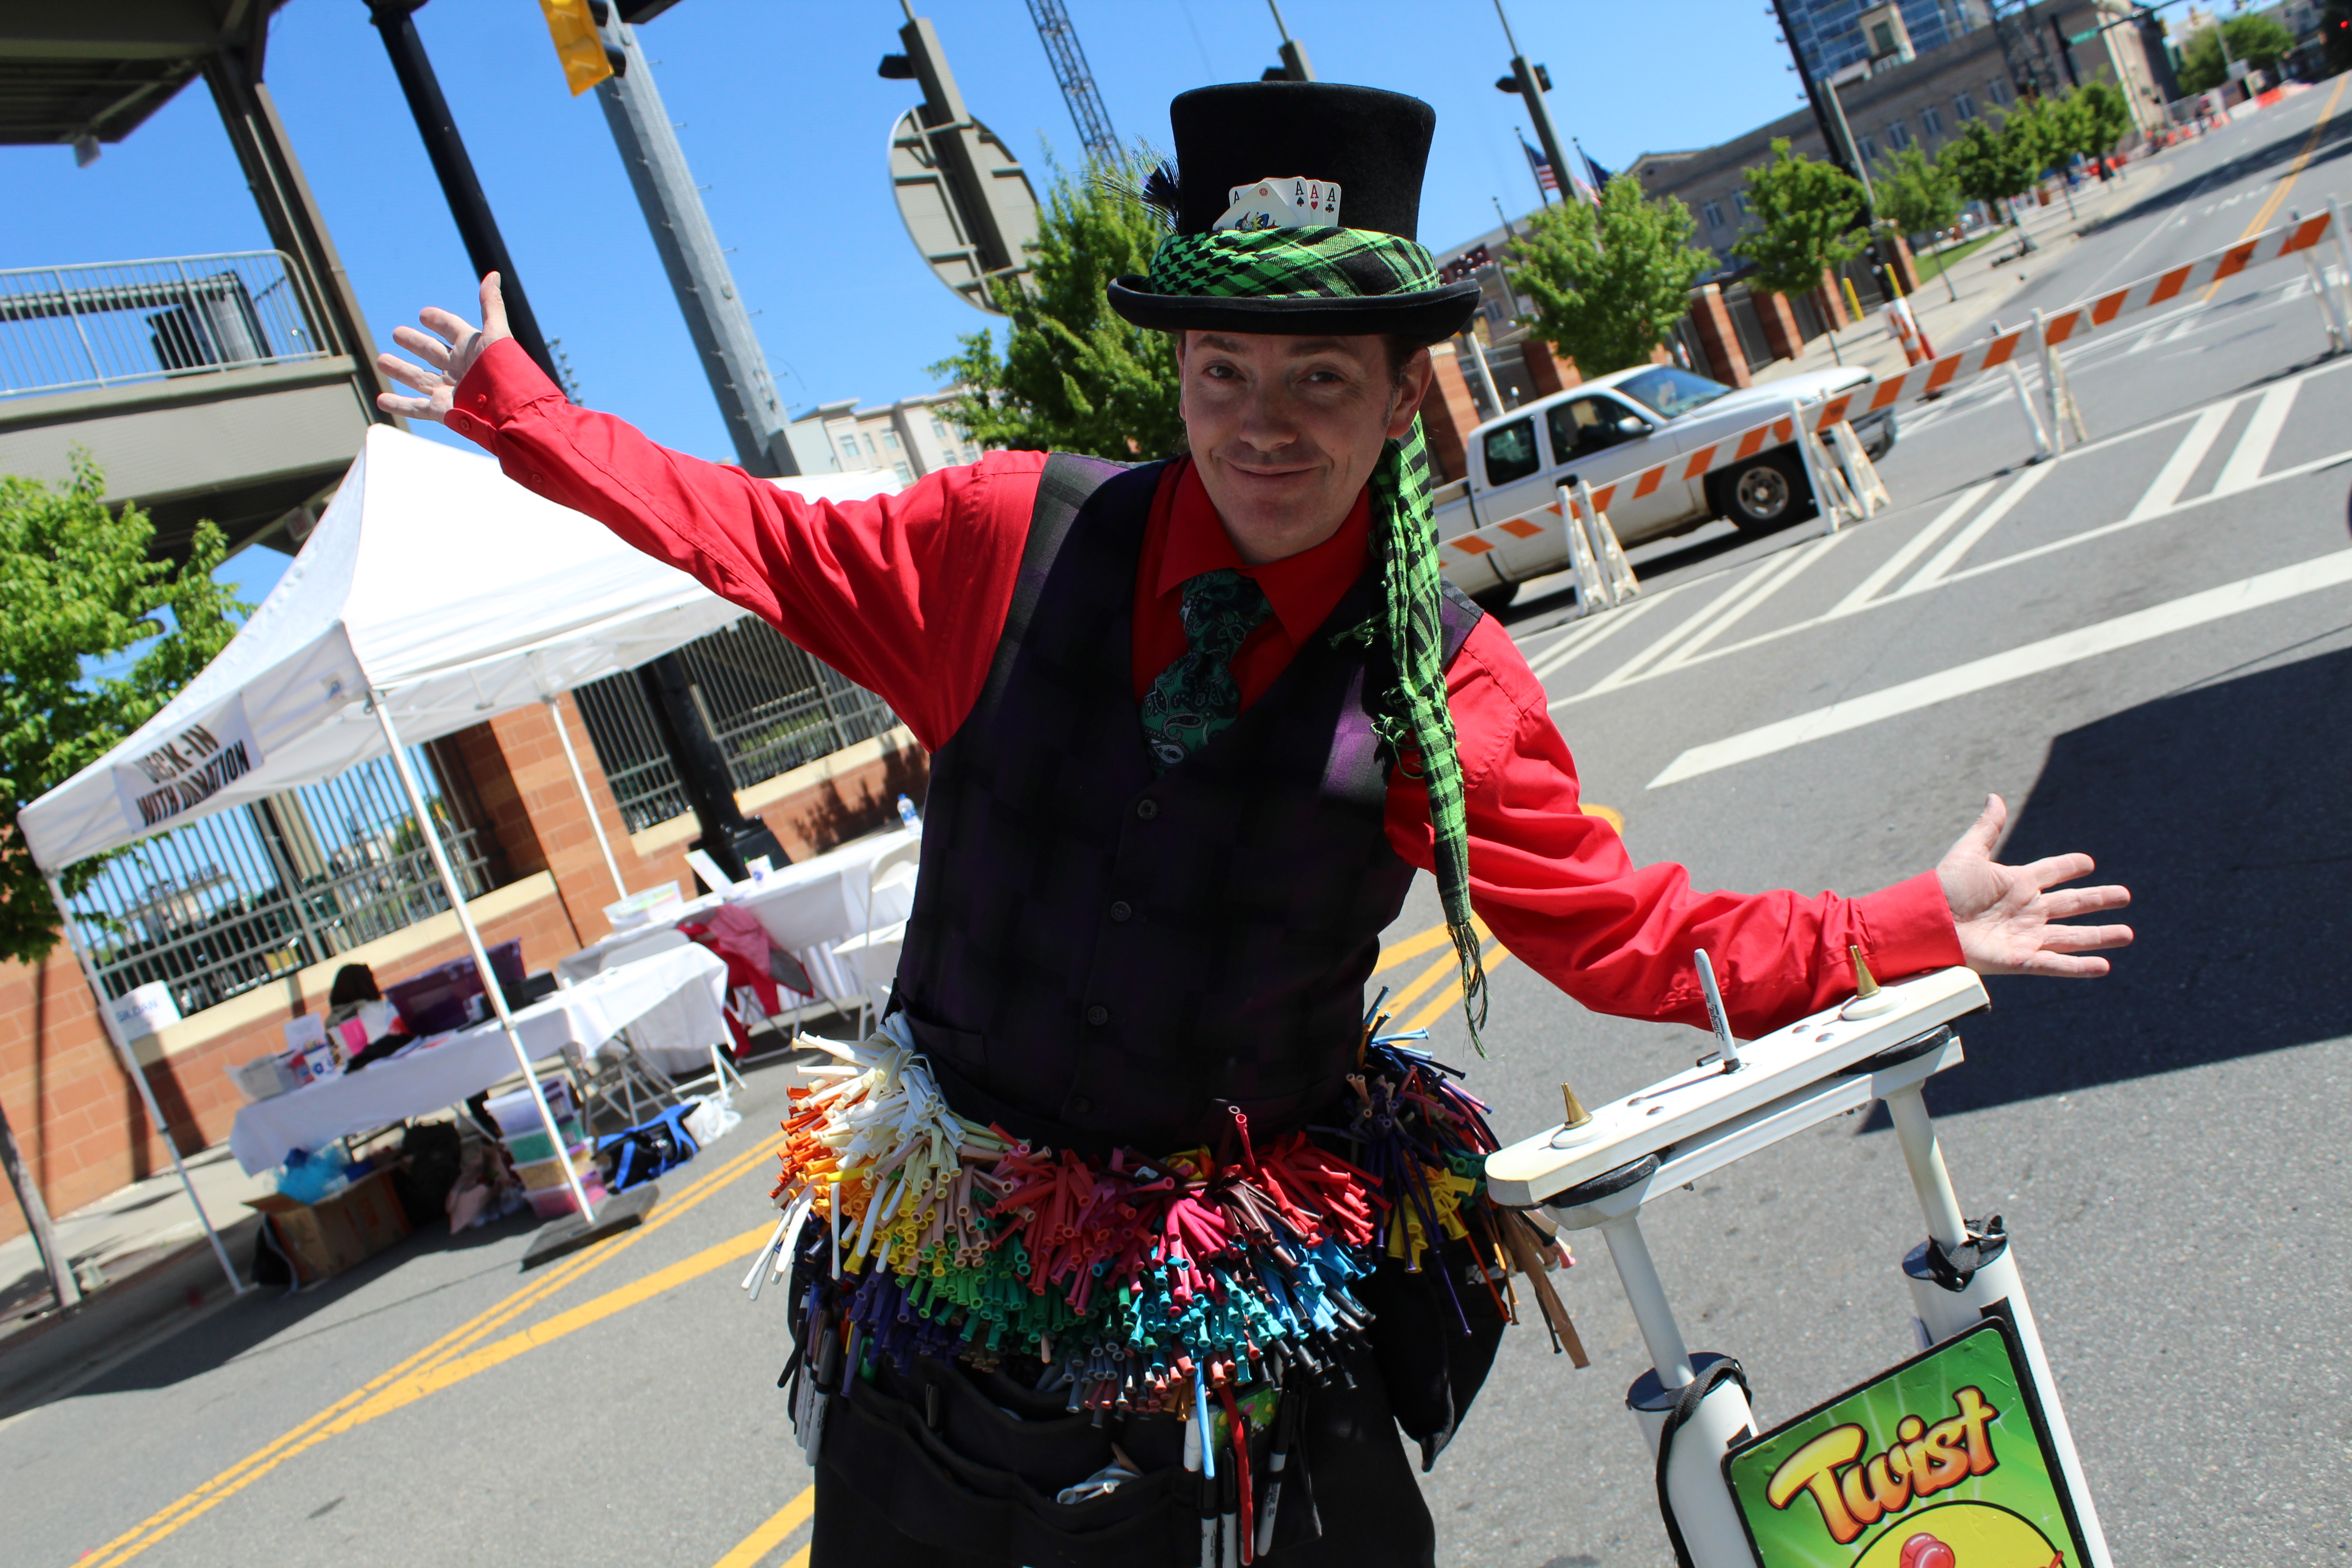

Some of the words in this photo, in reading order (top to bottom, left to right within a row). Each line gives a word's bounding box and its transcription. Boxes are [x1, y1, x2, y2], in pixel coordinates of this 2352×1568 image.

[1295, 181, 1304, 196] A
[1310, 184, 1319, 199] A
[1326, 187, 1336, 202] A
[1233, 191, 1240, 204] A
[1766, 1385, 2000, 1544] Twist
